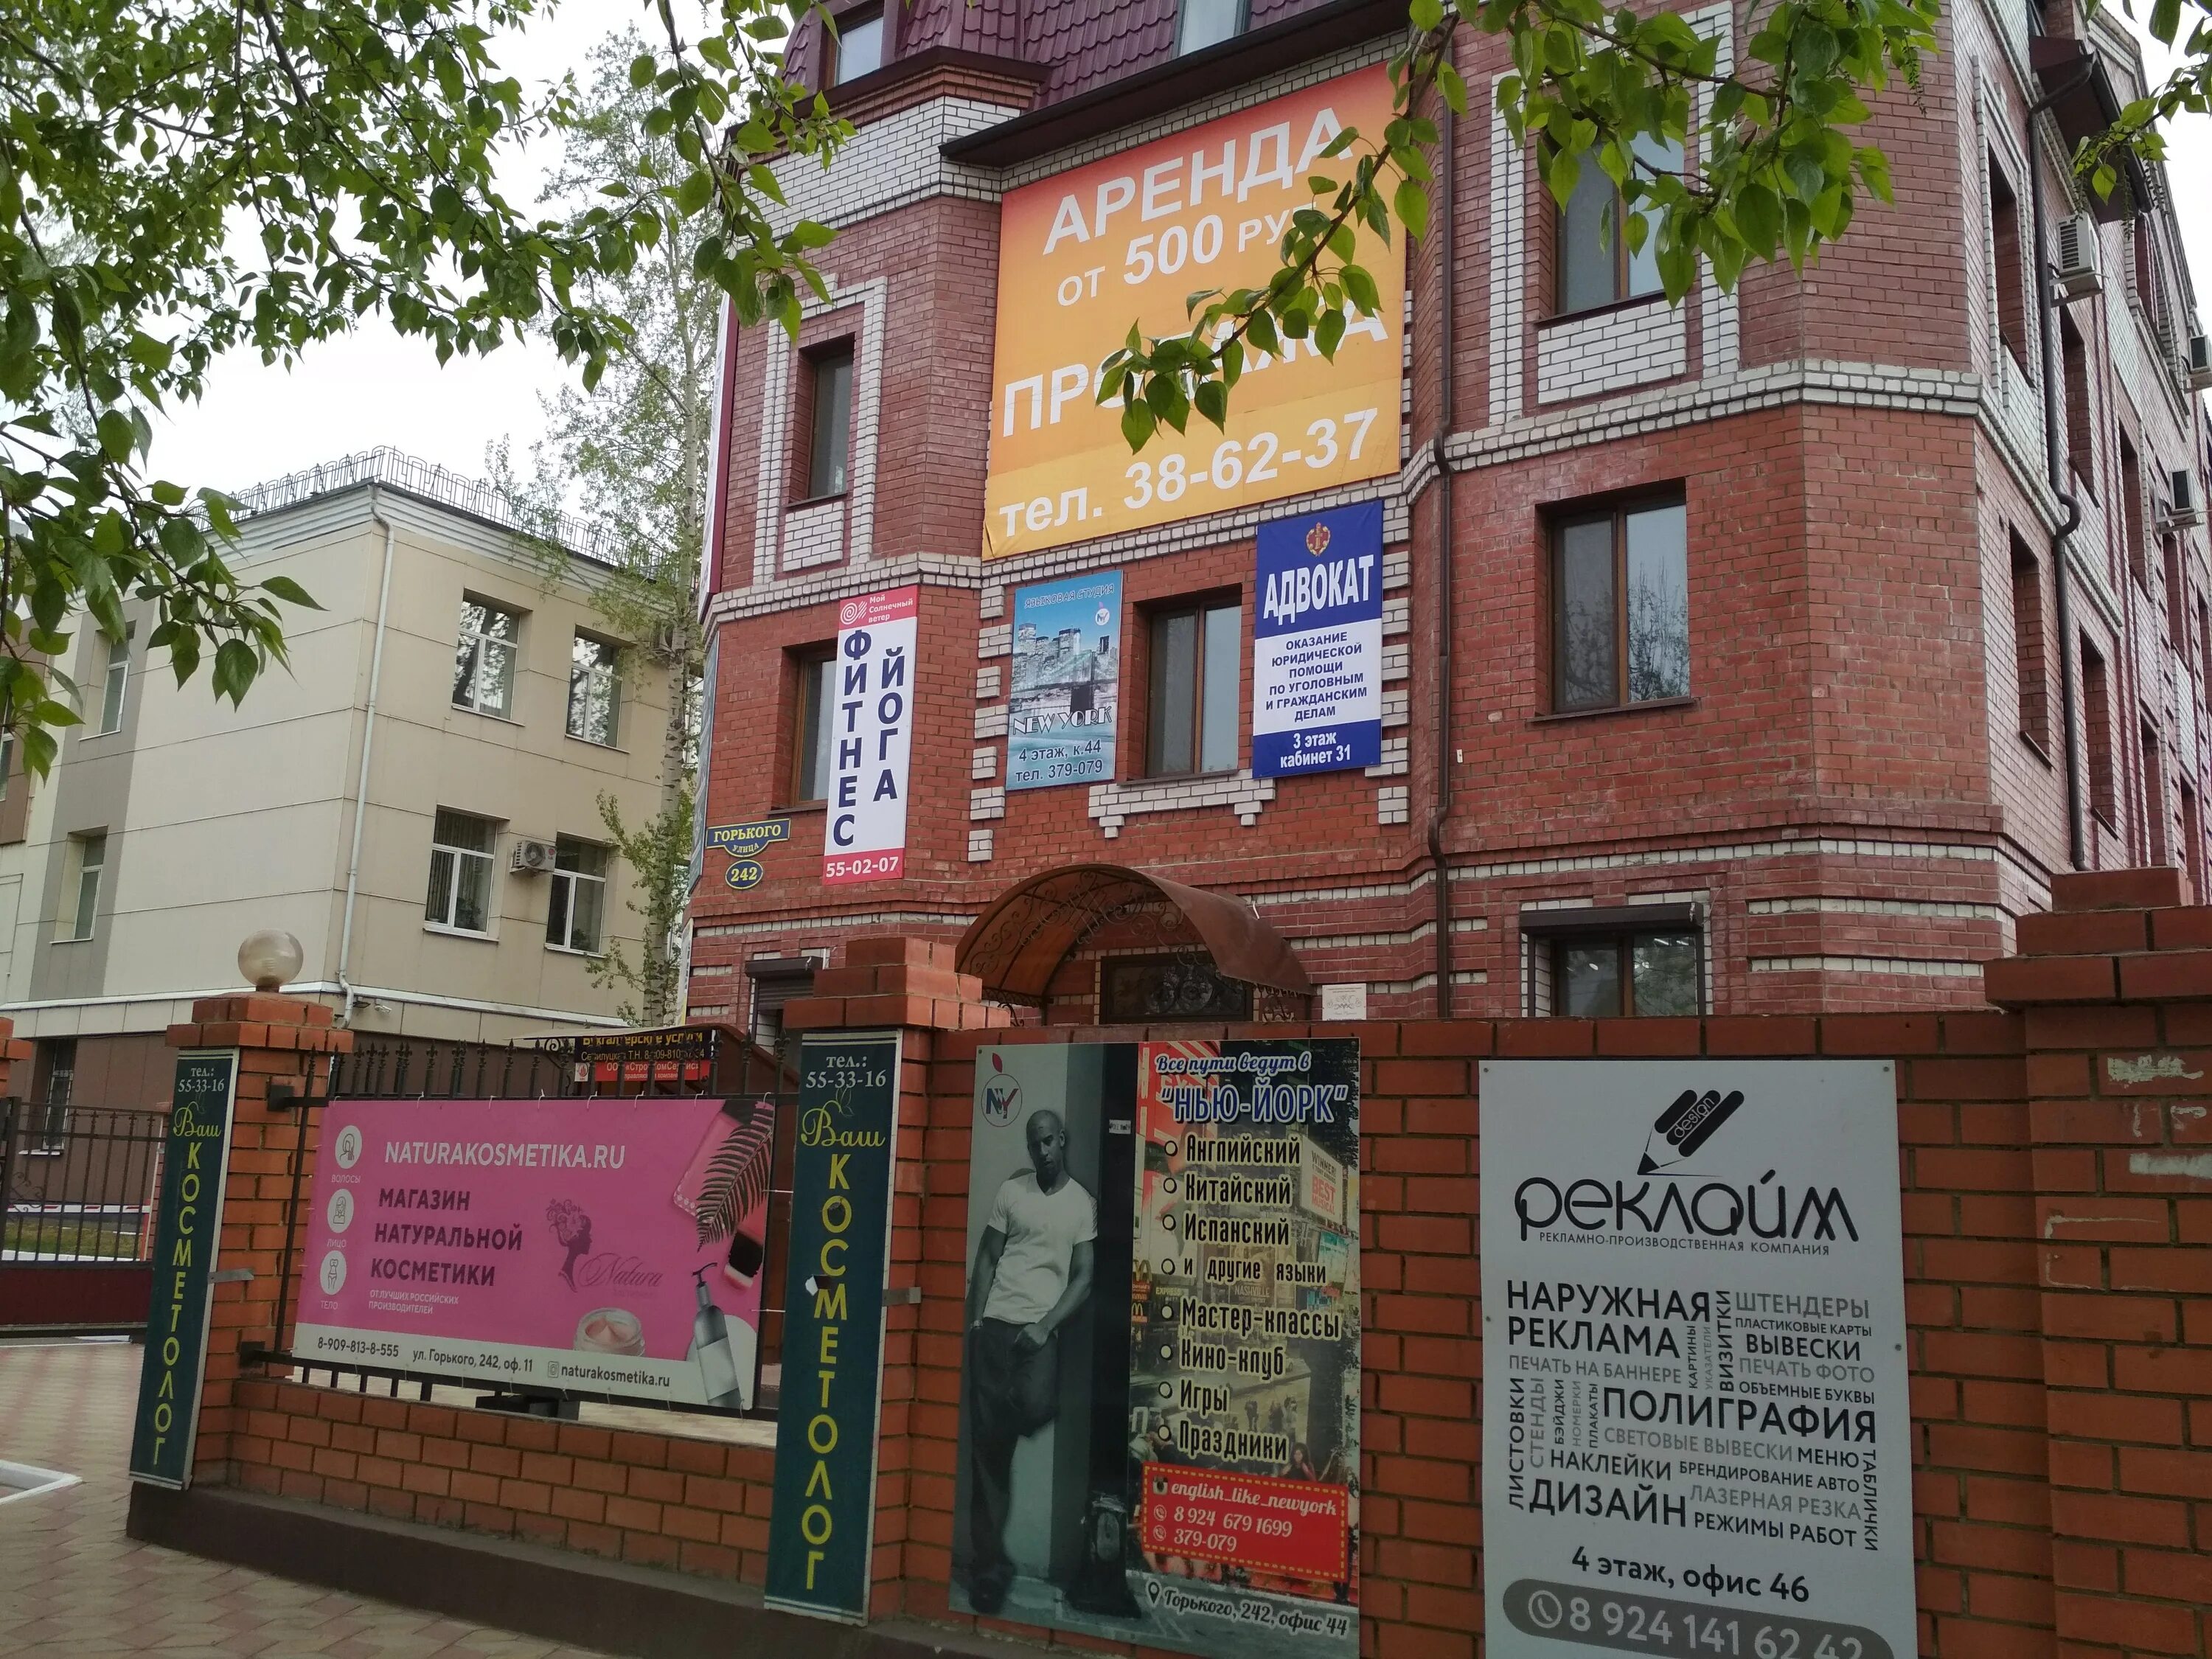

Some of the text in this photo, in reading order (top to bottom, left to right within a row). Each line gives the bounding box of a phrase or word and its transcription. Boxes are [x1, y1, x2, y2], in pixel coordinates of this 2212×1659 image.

[1043, 107, 1354, 254] АРЕНДА
[1122, 214, 1223, 285] 500
[999, 407, 1378, 537] тел. 38-62-37
[869, 594, 886, 604] Мой
[1024, 583, 1115, 609] ЯЗЫКОВАЯ СТУДИЯ
[1263, 554, 1374, 625] АДВОКАТ
[868, 613, 890, 623] ветер
[869, 598, 914, 613] Солнечный
[1271, 641, 1362, 667] ЮРИДИЧЕСКОЙ
[1285, 631, 1348, 651] ОКАЗАНИЕ
[1269, 672, 1364, 696] ПО УГОЛОВНЫМ
[1289, 661, 1343, 679] ПОМОЩИ
[1265, 686, 1368, 711] И ГРАЖДАНСКИМ
[872, 646, 905, 803] ЙОГА
[1012, 706, 1113, 735] NEW YORK
[1294, 706, 1336, 723] ДЕЛАМ
[832, 629, 872, 846] ФИТНЕС
[1019, 739, 1102, 762] 4 этаж, к.44
[1293, 731, 1337, 749] 3 этаж
[1015, 759, 1103, 782] тел. 379-079
[1279, 744, 1351, 769] кабинет 31
[714, 825, 782, 843] ГОРЬКОГО
[732, 842, 759, 853] УЛИЦА
[731, 866, 757, 882] 242
[826, 856, 900, 877] 55-02-07
[191, 1067, 215, 1077] тел.:
[826, 1056, 867, 1068] тел.:
[1155, 1053, 1310, 1075] Все пути ведут в
[178, 1079, 225, 1093] 55-33-16
[805, 1069, 886, 1089] 55-33-16
[1161, 1078, 1348, 1121] "НЬЮ-ЙОРК"
[173, 1102, 221, 1137] Ваш
[800, 1099, 886, 1147] Ваш
[1674, 1098, 1714, 1138] design
[385, 1141, 626, 1170] NATURAKOSMETIKA.RU
[1186, 1135, 1300, 1164] Английский
[331, 1174, 361, 1183] ВОЛОСЫ
[1186, 1174, 1291, 1204] Китайский
[378, 1188, 470, 1211] МАГАЗИН
[327, 1239, 347, 1248] ЛИЦО
[375, 1223, 522, 1251] НАТУРАЛЬНОЙ
[1185, 1213, 1289, 1245] Испанский
[1539, 1232, 1830, 1256] РЕКЛАМНО-ПРОИЗВОДСТВЕННАЯ КОМПАНИЯ
[371, 1258, 495, 1286] КОСМЕТИКИ
[1184, 1259, 1326, 1283] и другие языки
[153, 1142, 202, 1465] КОСМЕТОЛОГ
[321, 1301, 338, 1310] ТЕЛО
[369, 1301, 433, 1314] ПРОИЗВОДИТЕЛЕЙ
[370, 1290, 459, 1304] ОТ ЛУЧШИХ РОССИЙСКИХ
[1507, 1280, 1710, 1322] НАРУЖНАЯ
[1736, 1292, 1869, 1319] ШТЕНДЕРЫ
[1182, 1298, 1340, 1338] Мастер-классы
[1736, 1318, 1872, 1337] ПЛАСТИКОВЫЕ КАРТЫ
[1509, 1315, 1680, 1359] РЕКЛАМА
[1717, 1290, 1734, 1392] ВИЗИТКИ
[1746, 1333, 1860, 1361] ВЫВЕСКИ
[317, 1337, 533, 1374] 8-909-813-8-555 ул. Горького, 242, оф. 11
[1181, 1339, 1284, 1380] Кино-клуб
[1509, 1355, 1681, 1384] ПЕЧАТЬ НА БАННЕРЕ
[1687, 1326, 1698, 1389] КАРТИНЫ
[1704, 1326, 1713, 1390] УКАЗАТЕЛИ
[1739, 1357, 1875, 1383] ПЕЧАТЬ ФОТО
[561, 1363, 671, 1388] naturakosmetika.ru
[801, 1154, 852, 1590] КОСМЕТОЛОГ
[1180, 1380, 1228, 1415] Игры
[1739, 1380, 1875, 1404] ОБЪЕМНЫЕ БУКВЫ
[1530, 1377, 1546, 1469] СТЕНДЫ
[1554, 1380, 1566, 1445] БЭЙДЖИ
[1573, 1381, 1582, 1447] НОМЕРКИ
[1590, 1383, 1598, 1449] ПЛАКАТЫ
[1604, 1387, 1876, 1444] ПОЛИГРАФИЯ
[1180, 1422, 1288, 1461] Праздники
[1509, 1377, 1525, 1510] ЛИСТОВКИ
[1604, 1427, 1792, 1461] СВЕТОВЫЕ ВЫВЕСКИ
[1551, 1449, 1671, 1481] НАКЛЕЙКИ
[1798, 1447, 1860, 1468] МЕНЮ
[1680, 1461, 1860, 1493] БРЕНДИРОВАНИЕ АВТО
[1171, 1481, 1337, 1517] english_like_newyork
[1529, 1478, 1686, 1528] ДИЗАЙН
[1690, 1485, 1862, 1520] ЛАЗЕРНАЯ РЕЗКА
[1863, 1450, 1879, 1551] ТАБЛИЧКИ
[1174, 1506, 1293, 1537] 8 924 679 1699
[1695, 1512, 1857, 1546] РЕЖИМЫ РАБОТ
[1173, 1528, 1237, 1552] 379-079
[1572, 1546, 1809, 1602] 4 этаж, офис 46
[1164, 1590, 1347, 1636] Горького, 242, офис 44
[1570, 1597, 1591, 1632] 8
[1603, 1601, 1672, 1645] 924
[1683, 1615, 1739, 1655] 141
[1755, 1626, 1800, 1659] 62
